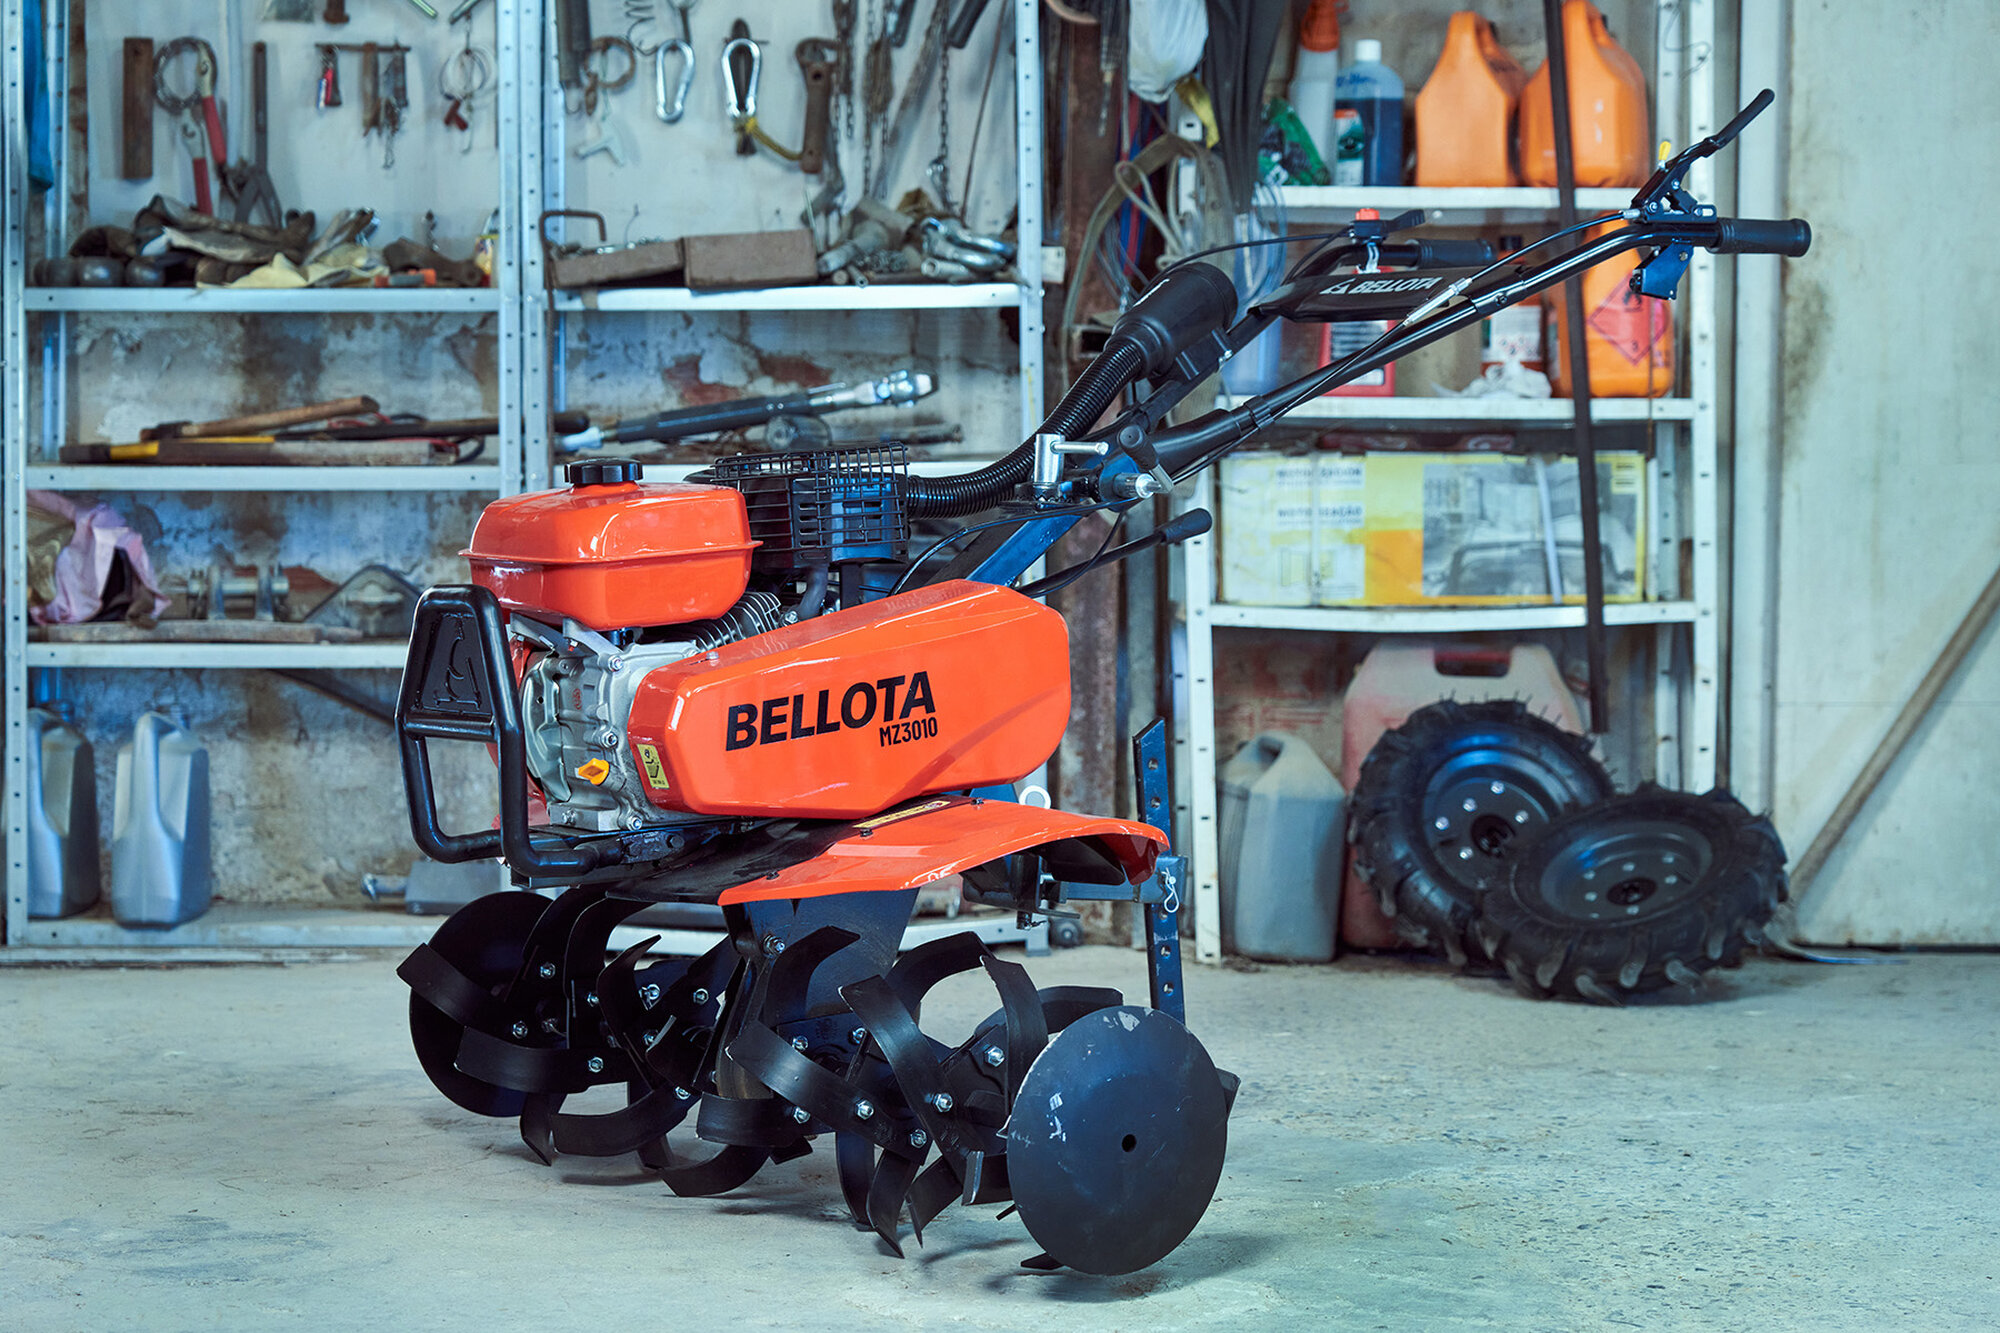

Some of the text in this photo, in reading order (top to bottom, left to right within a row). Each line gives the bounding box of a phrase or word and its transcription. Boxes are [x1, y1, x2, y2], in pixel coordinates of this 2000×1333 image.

[1348, 277, 1443, 295] BELLOTA
[725, 671, 936, 751] BELLOTA
[879, 717, 938, 747] MZ3010
